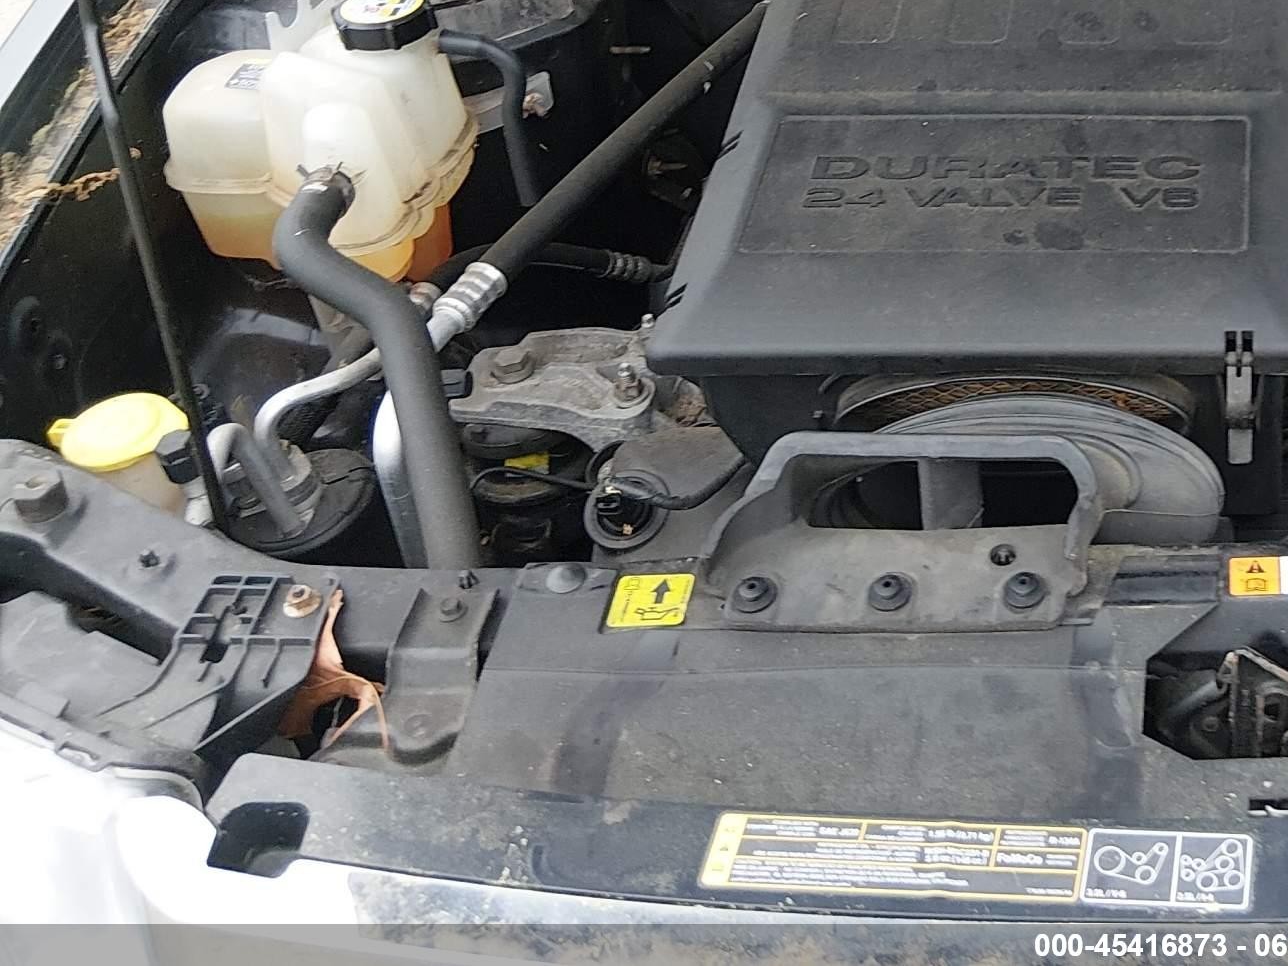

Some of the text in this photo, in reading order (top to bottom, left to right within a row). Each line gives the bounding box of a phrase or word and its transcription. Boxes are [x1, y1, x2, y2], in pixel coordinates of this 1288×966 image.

[811, 155, 1202, 181] DURATEC
[802, 187, 1202, 208] 24 VALVE V6
